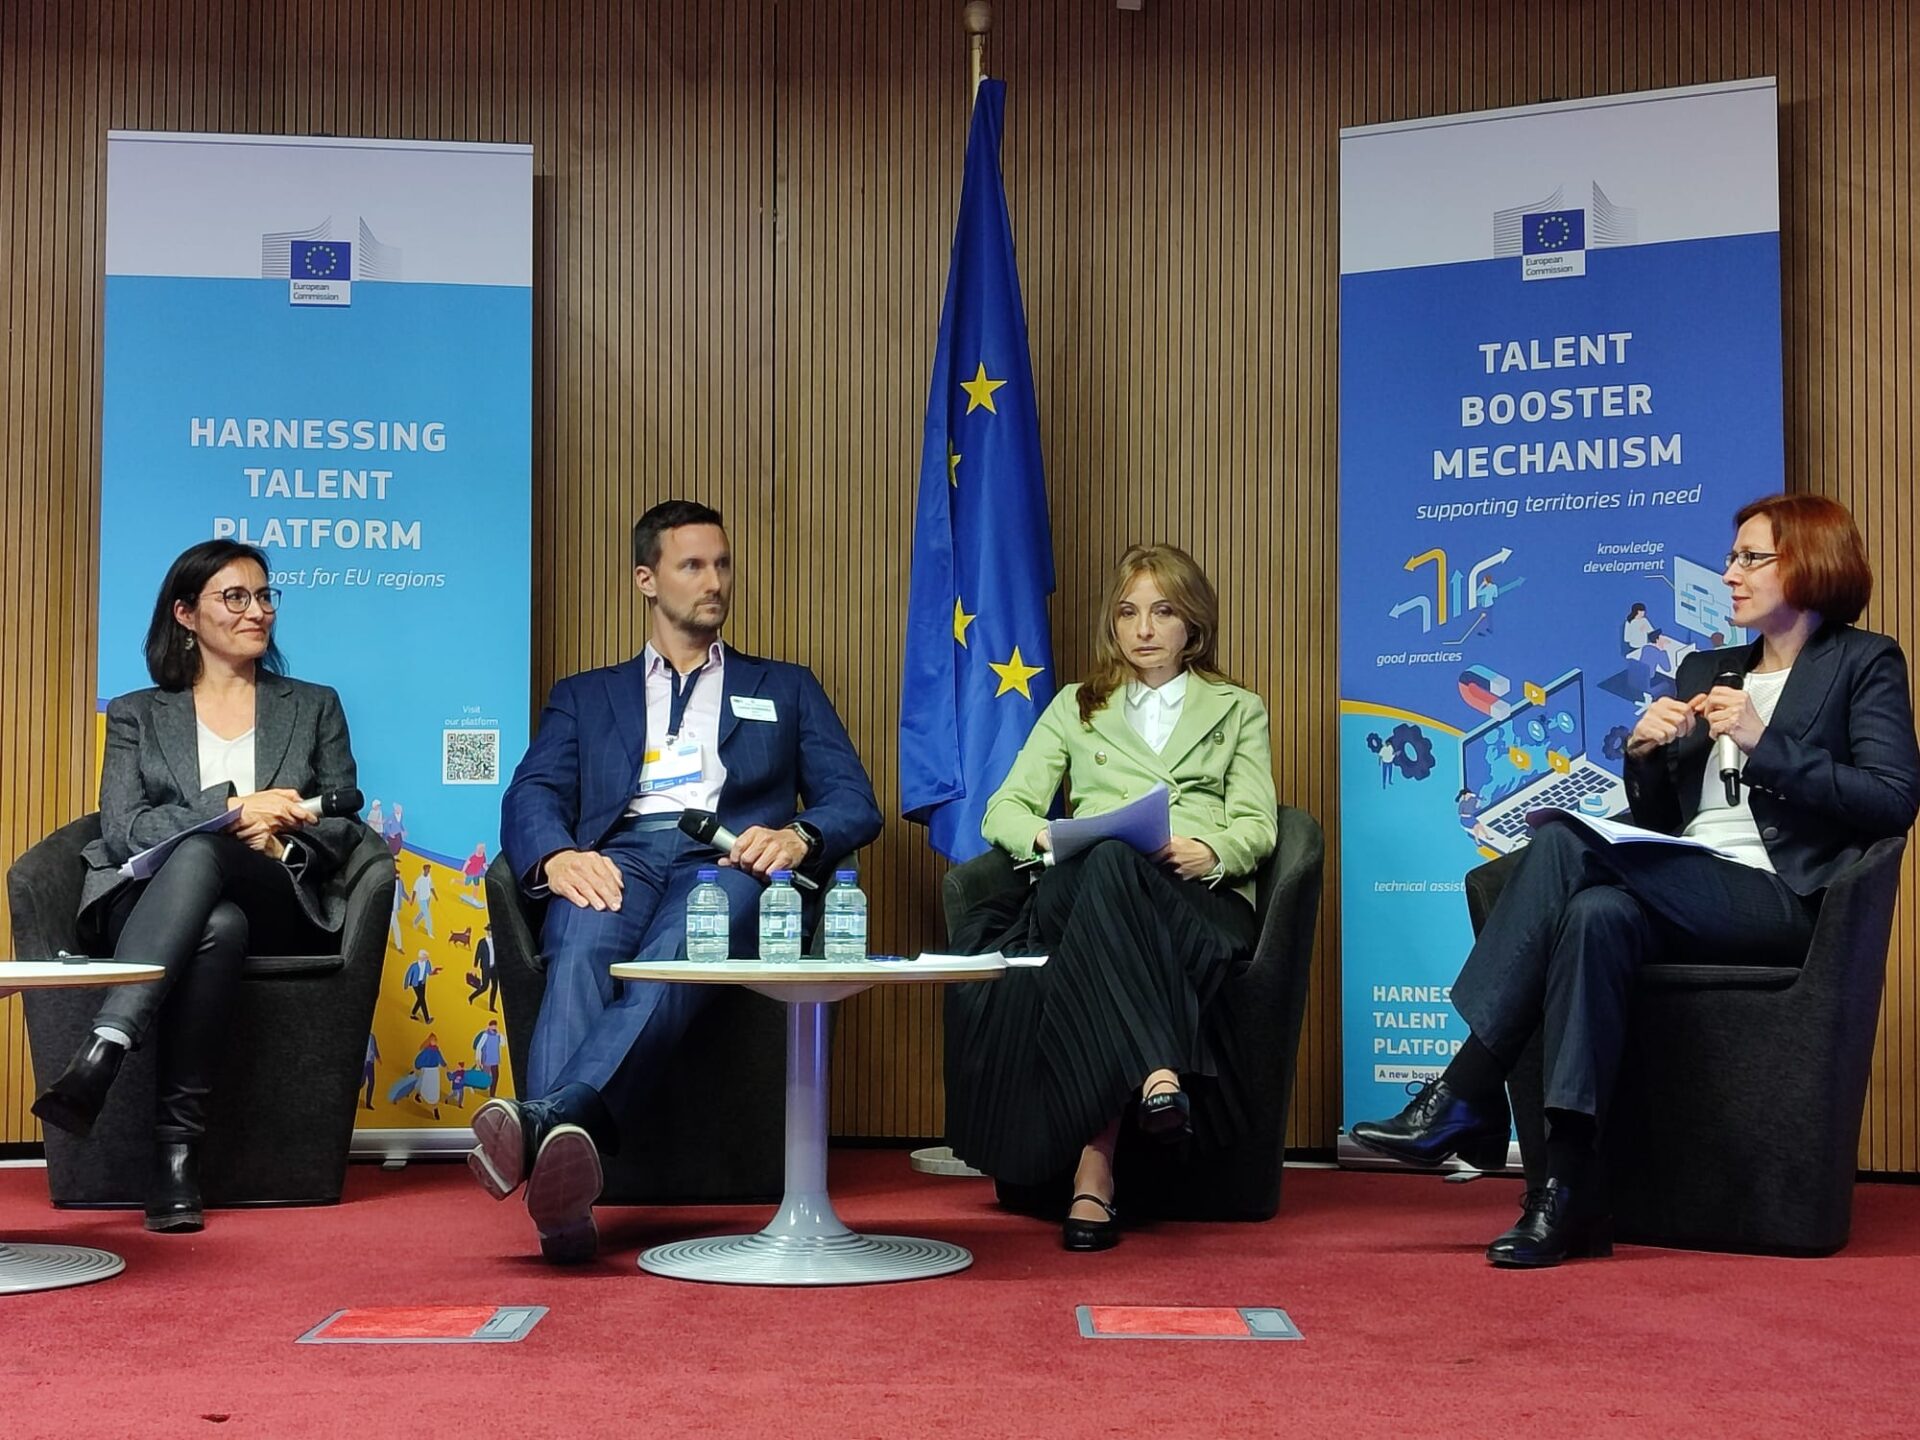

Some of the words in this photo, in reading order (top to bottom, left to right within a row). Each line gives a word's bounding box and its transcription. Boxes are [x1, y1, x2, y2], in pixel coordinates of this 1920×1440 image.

[1526, 256, 1564, 267] European
[1526, 266, 1574, 276] Commission
[293, 282, 330, 292] European
[293, 292, 339, 301] Commission
[1478, 331, 1633, 374] TALENT
[1460, 383, 1653, 428] BOOSTER
[190, 416, 447, 452] HARNESSING
[1432, 433, 1683, 481] MECHANISM
[243, 467, 393, 500] TALENT
[1416, 498, 1519, 522] supporting
[1525, 492, 1621, 512] territories
[1627, 490, 1646, 506] in
[1651, 483, 1702, 505] need
[212, 517, 422, 550] PLATFORM
[1597, 540, 1664, 557] knowledge
[1583, 559, 1665, 575] development
[268, 569, 307, 585] oost
[308, 568, 341, 588] for
[344, 569, 371, 585] EU
[376, 570, 446, 591] regions
[1376, 653, 1406, 666] good
[1409, 650, 1463, 666] practices
[462, 705, 481, 714] Visit
[444, 718, 459, 726] our
[461, 717, 499, 727] platform
[1374, 880, 1426, 892] technical
[1429, 881, 1465, 892] assist
[1373, 985, 1452, 1003] HARNES
[1373, 1012, 1449, 1029] TALENT
[1374, 1038, 1462, 1056] PLATFOR
[1378, 1069, 1386, 1079] A
[1388, 1071, 1409, 1080] new
